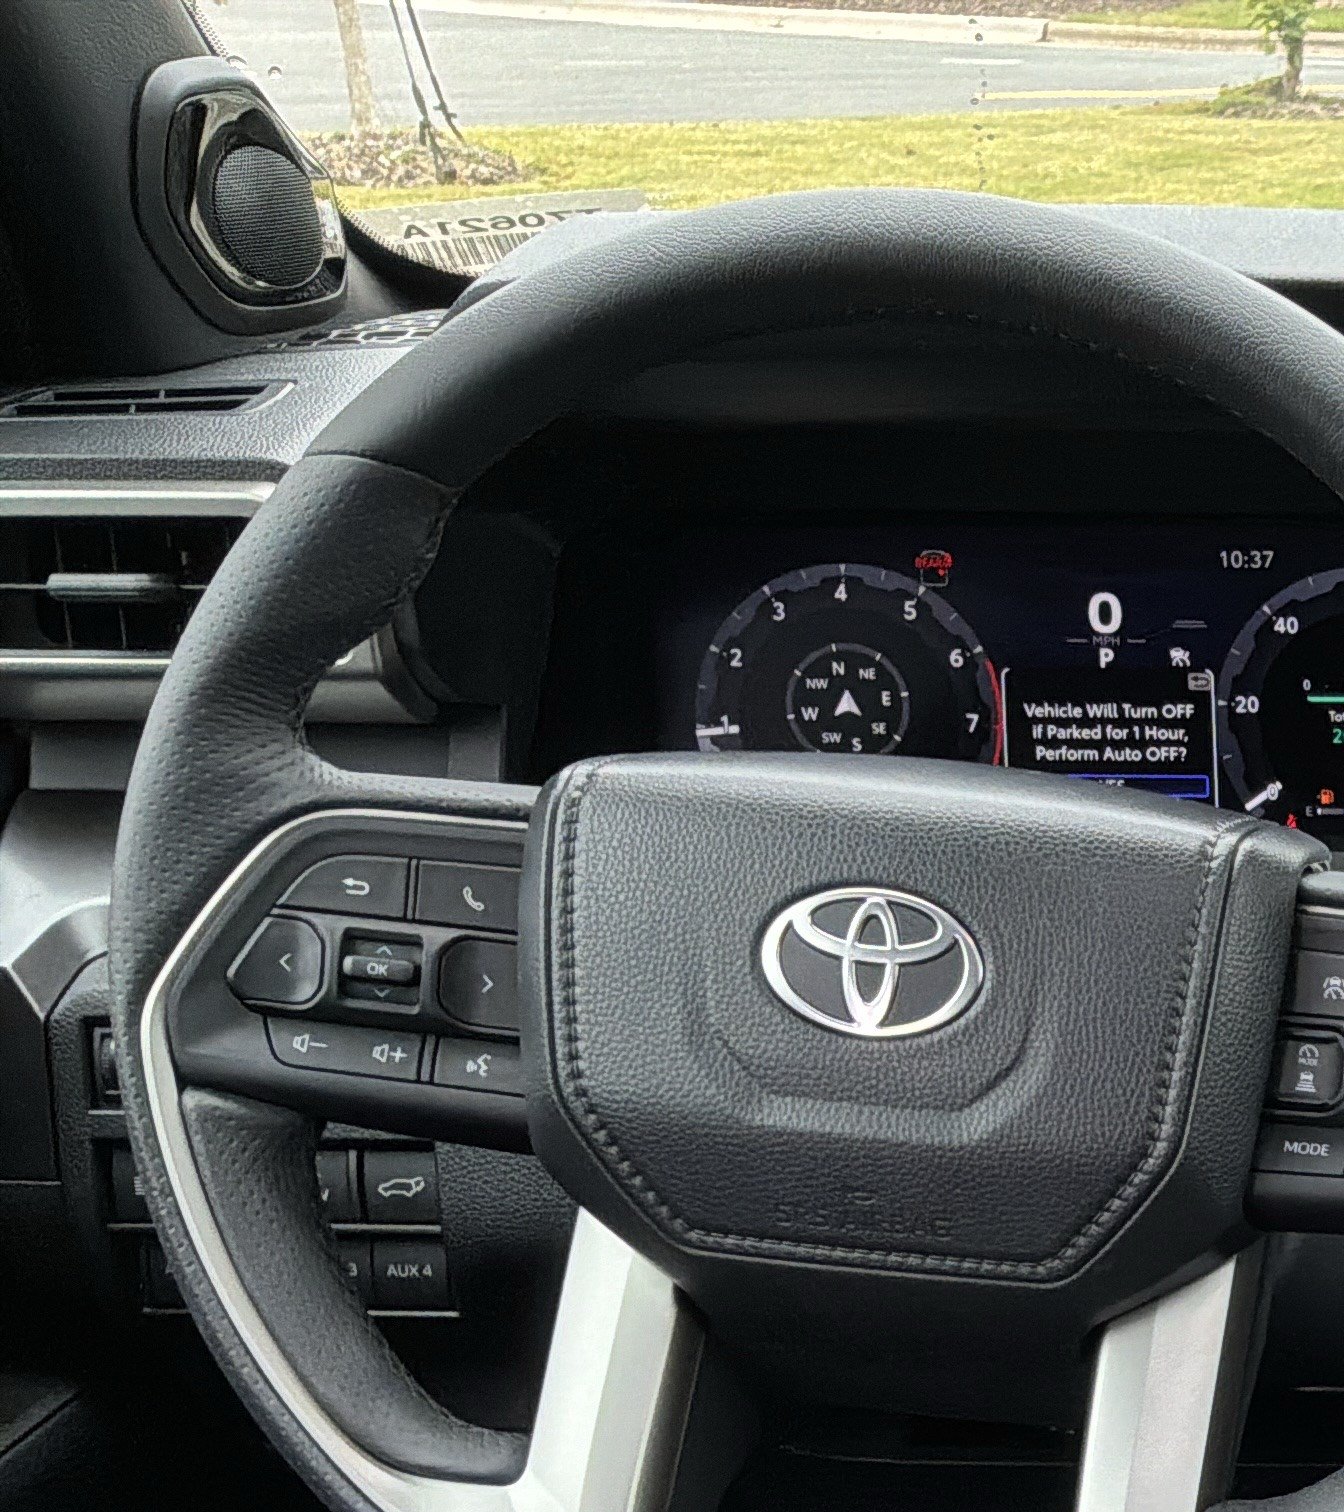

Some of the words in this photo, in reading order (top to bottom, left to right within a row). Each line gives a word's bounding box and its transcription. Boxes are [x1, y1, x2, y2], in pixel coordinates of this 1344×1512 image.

[1220, 550, 1274, 570] 10:37
[834, 584, 848, 601] 4
[772, 602, 785, 620] 3
[903, 601, 917, 620] 5
[1088, 592, 1122, 633] 0
[1274, 617, 1298, 635] 40
[729, 649, 743, 667] 2
[949, 649, 963, 667] 6
[1100, 648, 1114, 668] P
[832, 661, 845, 675] N
[859, 667, 876, 680] NE
[805, 678, 828, 690] NW
[1303, 680, 1311, 691] 0
[881, 692, 891, 706] E
[1235, 696, 1259, 713] 20
[801, 707, 818, 721] W
[1023, 703, 1082, 718] Vehicle
[1086, 703, 1118, 718] Will
[1122, 703, 1157, 718] Turn
[1162, 704, 1194, 718] OFF
[871, 722, 887, 735] SE
[965, 714, 979, 733] 7
[821, 732, 841, 744] SW
[1032, 724, 1043, 740] if
[1047, 724, 1100, 740] Parked
[1106, 725, 1129, 740] for
[1133, 725, 1140, 740] 1
[1145, 726, 1188, 742] Hour,
[852, 738, 862, 751] S
[1035, 745, 1098, 761] Perform
[1103, 746, 1142, 761] Auto
[1146, 747, 1187, 762] OFF?
[1305, 805, 1312, 816] E
[366, 963, 388, 976] OK
[1283, 1140, 1330, 1157] MODE
[348, 1265, 358, 1277] 3
[386, 1264, 419, 1279] AUX
[421, 1264, 433, 1278] 4
